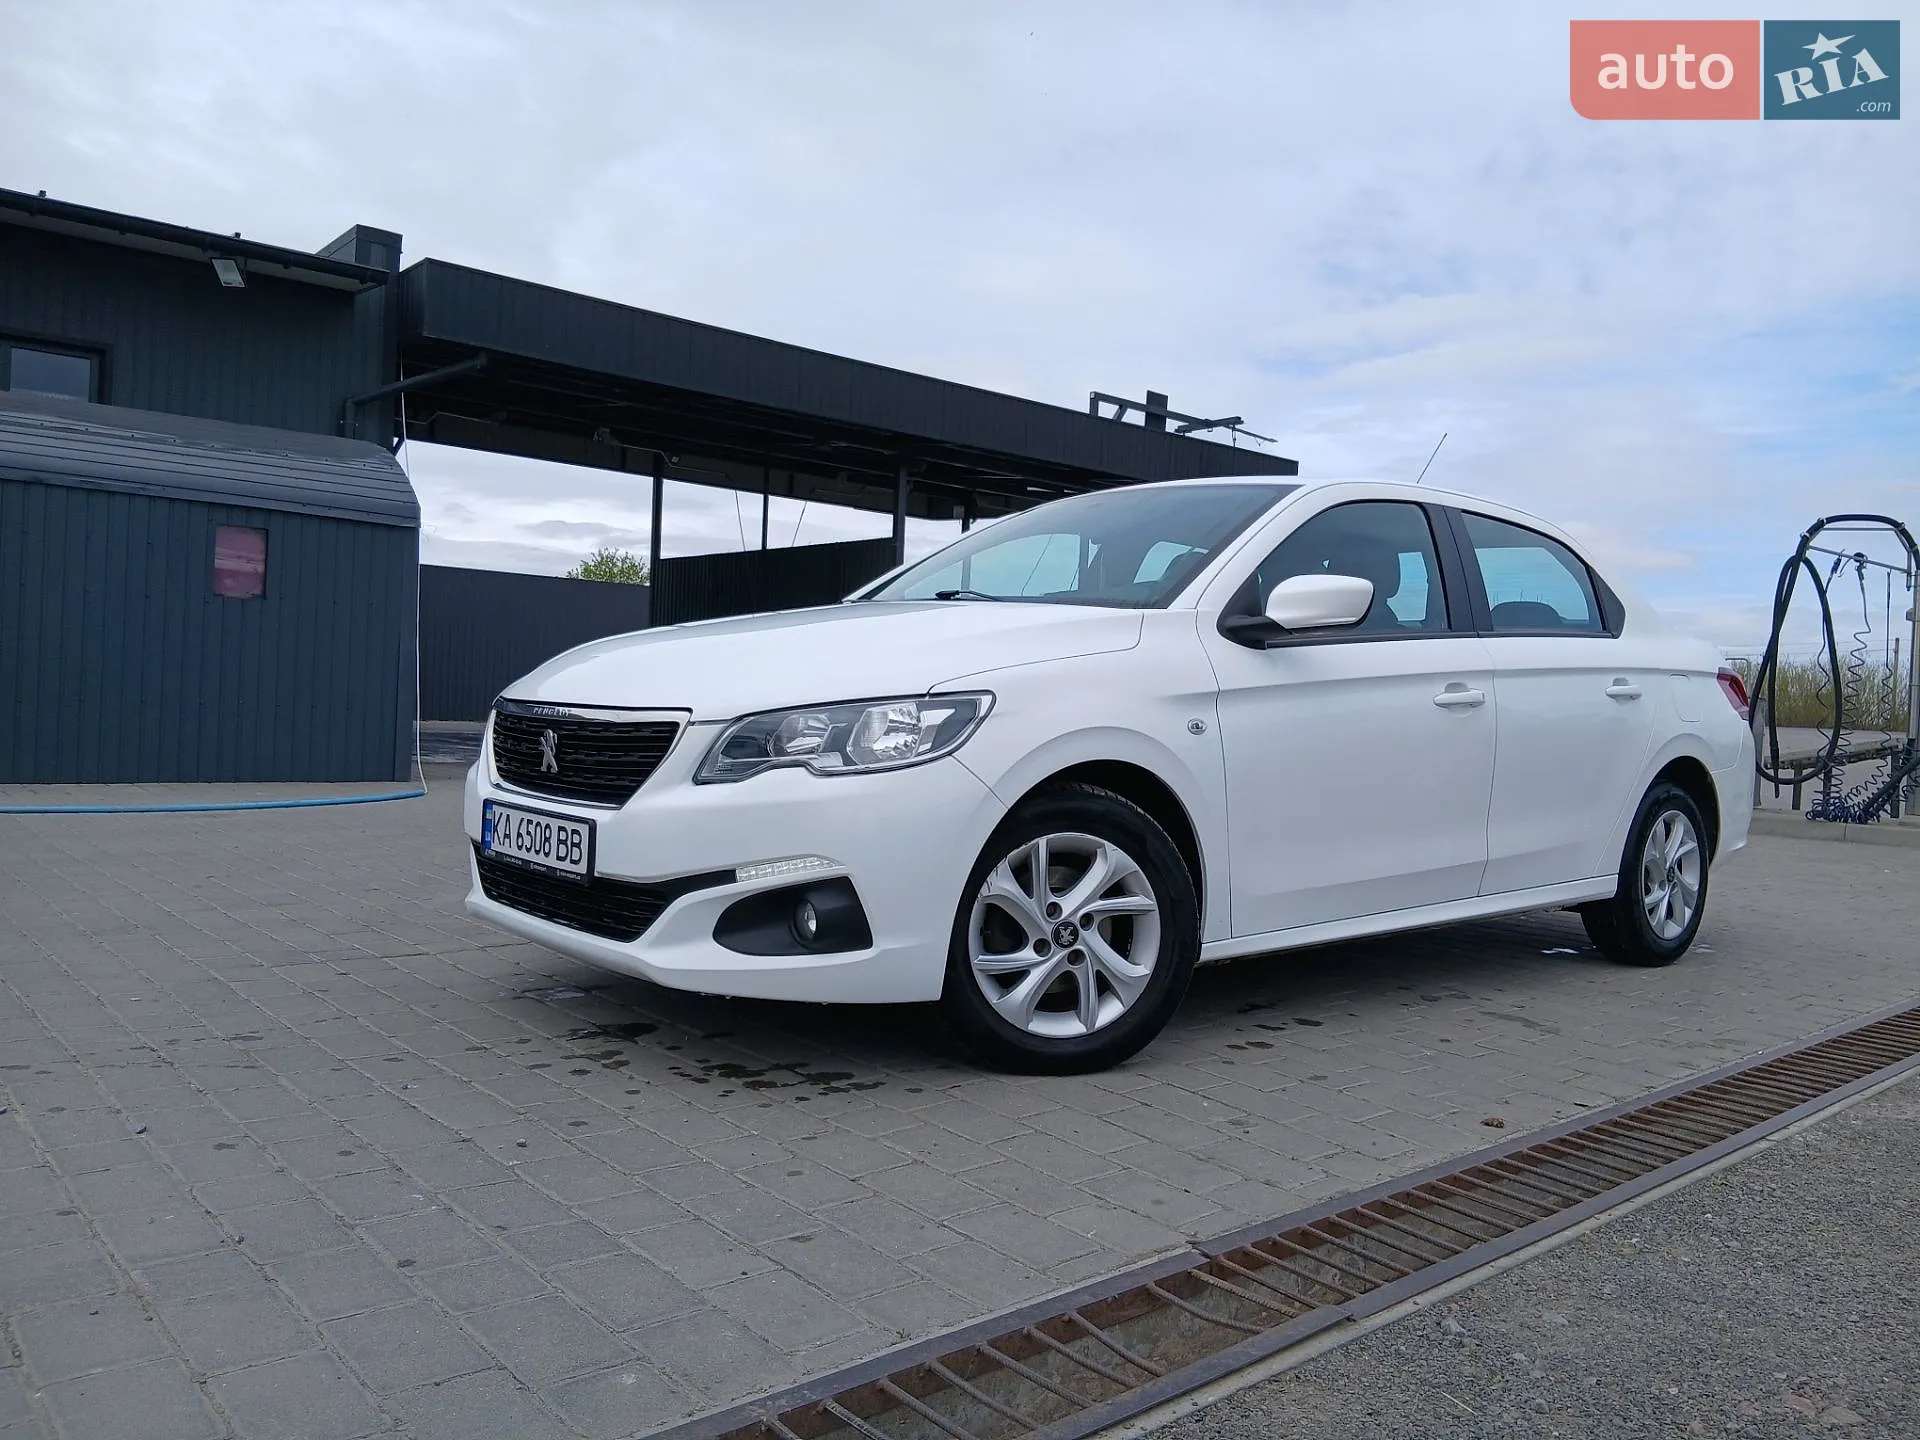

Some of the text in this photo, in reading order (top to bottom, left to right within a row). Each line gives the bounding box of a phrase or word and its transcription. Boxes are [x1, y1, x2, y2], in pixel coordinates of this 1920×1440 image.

[492, 810, 583, 866] KA 6508 BB
